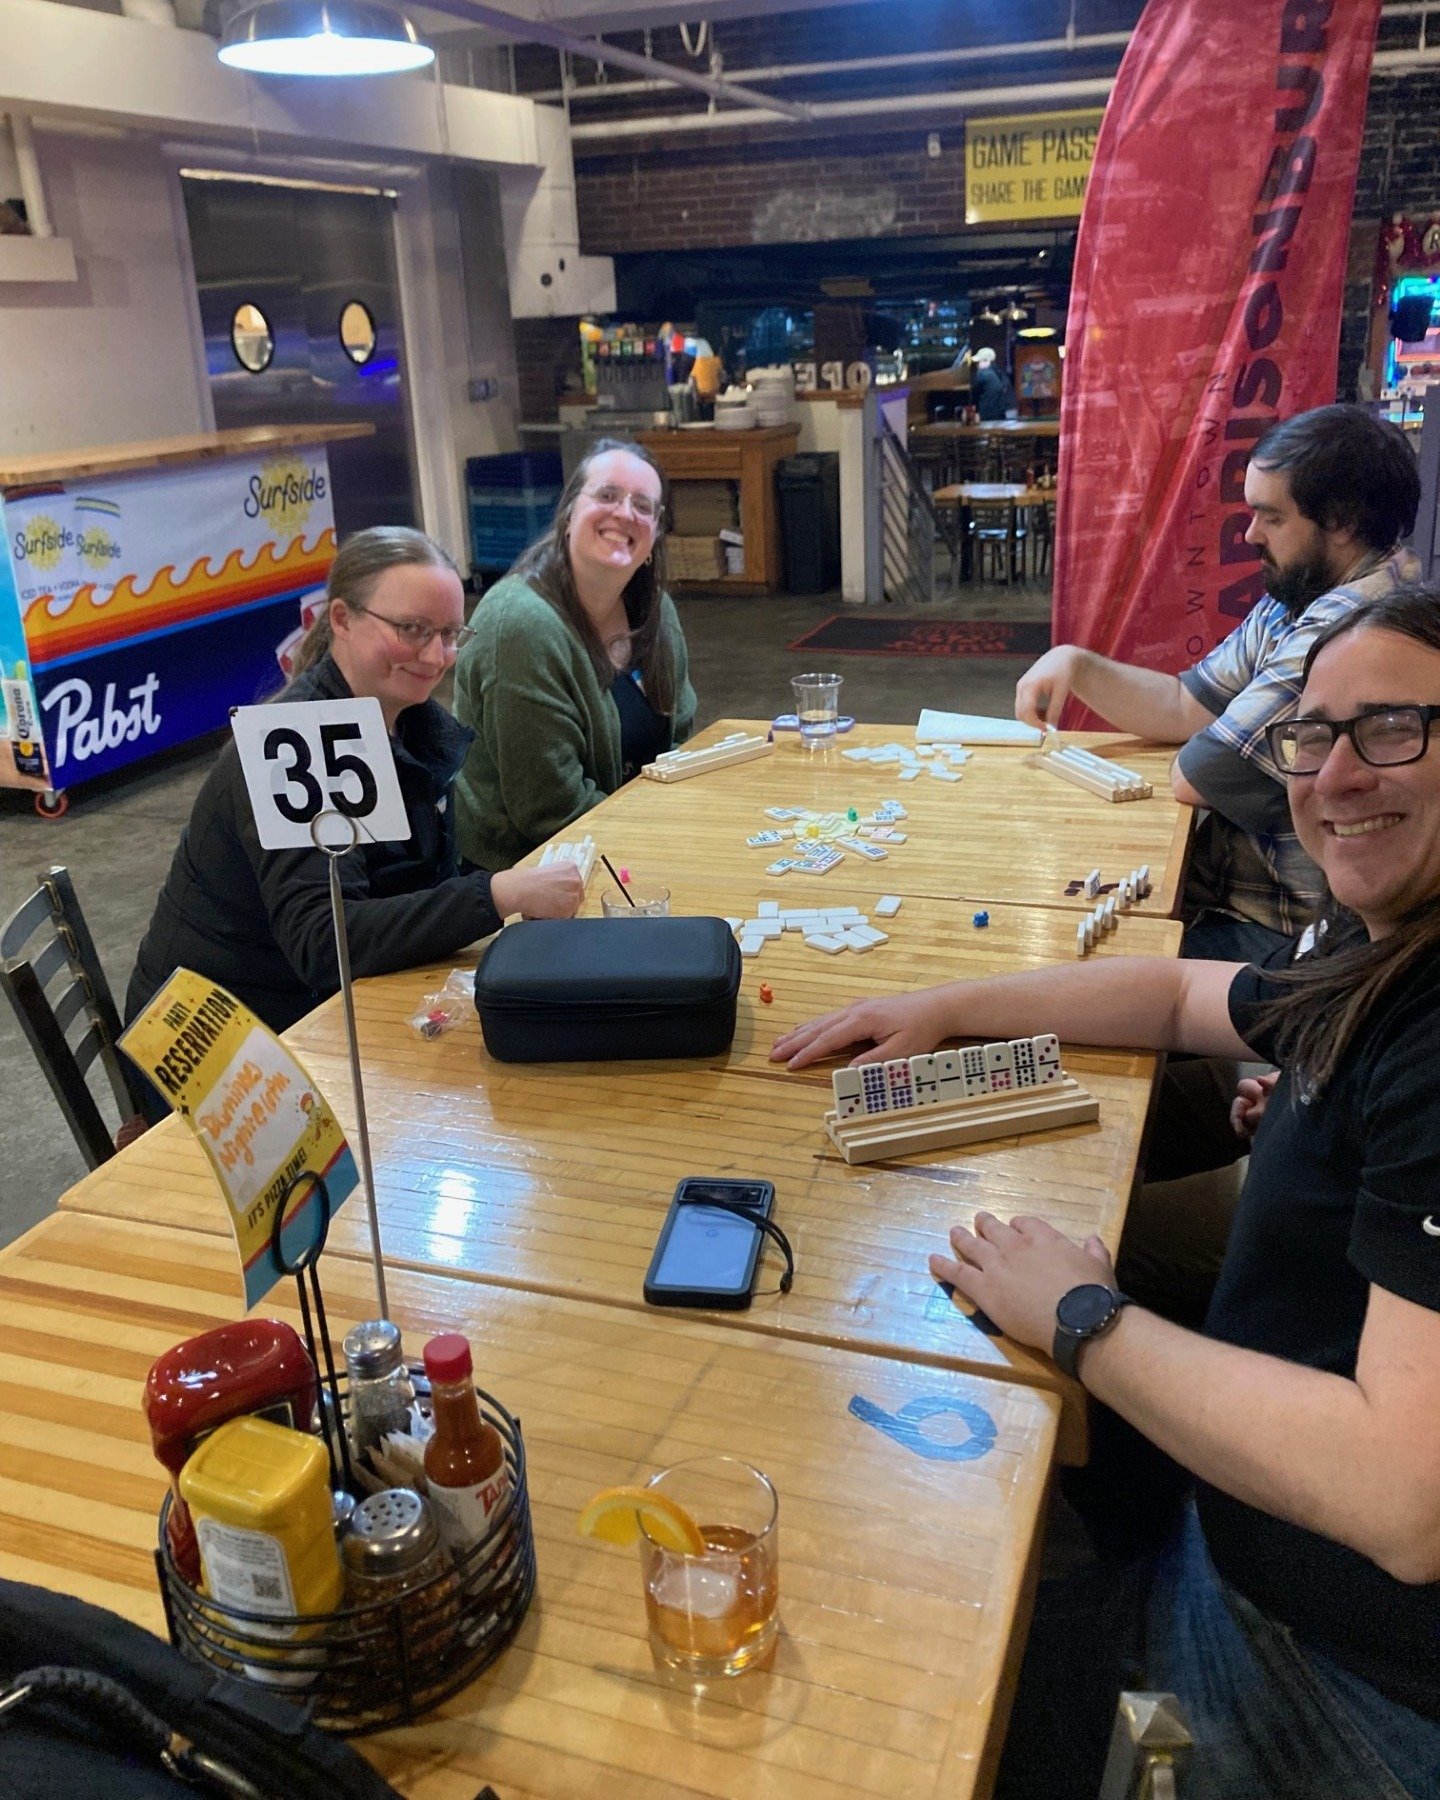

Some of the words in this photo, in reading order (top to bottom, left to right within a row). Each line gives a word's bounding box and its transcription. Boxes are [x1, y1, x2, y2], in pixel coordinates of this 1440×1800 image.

[971, 130, 1032, 170] GAME
[1041, 124, 1098, 164] PASS
[970, 180, 1016, 206] SHARE
[1021, 177, 1048, 202] THE
[1053, 174, 1088, 200] GAM
[1216, 0, 1335, 645] ARRISONBUR
[243, 468, 326, 518] Surfside
[1186, 371, 1227, 656] OWNTOWN
[14, 526, 75, 560] Surfside
[41, 672, 162, 768] Pabst
[263, 722, 378, 824] 35
[162, 1001, 192, 1032] PARTY
[154, 988, 239, 1096] RESERVATION
[264, 1174, 288, 1209] PIZZA
